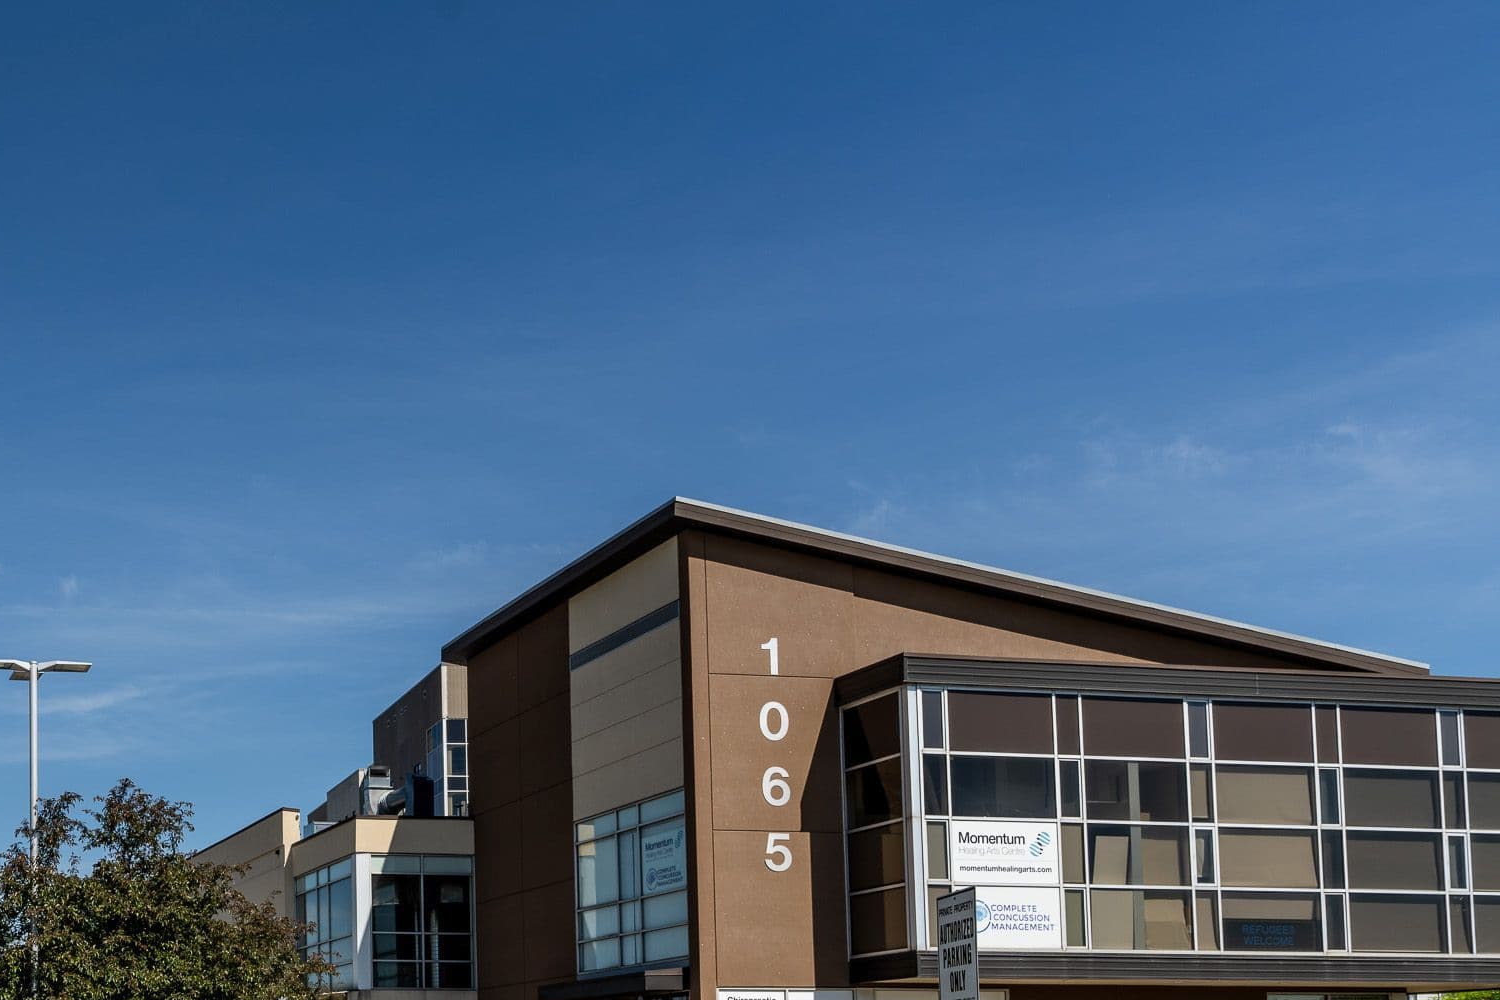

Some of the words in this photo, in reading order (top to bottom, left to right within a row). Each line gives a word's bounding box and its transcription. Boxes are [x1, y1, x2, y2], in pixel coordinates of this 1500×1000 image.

[759, 638, 793, 872] 1065
[645, 838, 673, 851] Momentum
[958, 831, 1026, 845] Momentum
[958, 846, 985, 857] Healing
[986, 847, 1000, 856] Arts
[1001, 847, 1026, 856] Centre
[959, 865, 1053, 874] momentumhealingarts.com
[953, 900, 973, 914] PROPERTY
[991, 904, 1037, 912] COMPLETE
[993, 914, 1050, 922] CONCUSSION
[939, 917, 974, 945] AUTHORIZED
[991, 923, 1055, 931] MANAGEMENT
[1243, 935, 1295, 945] WELCOME
[943, 944, 972, 969] PARKING
[950, 970, 966, 993] ONLY
